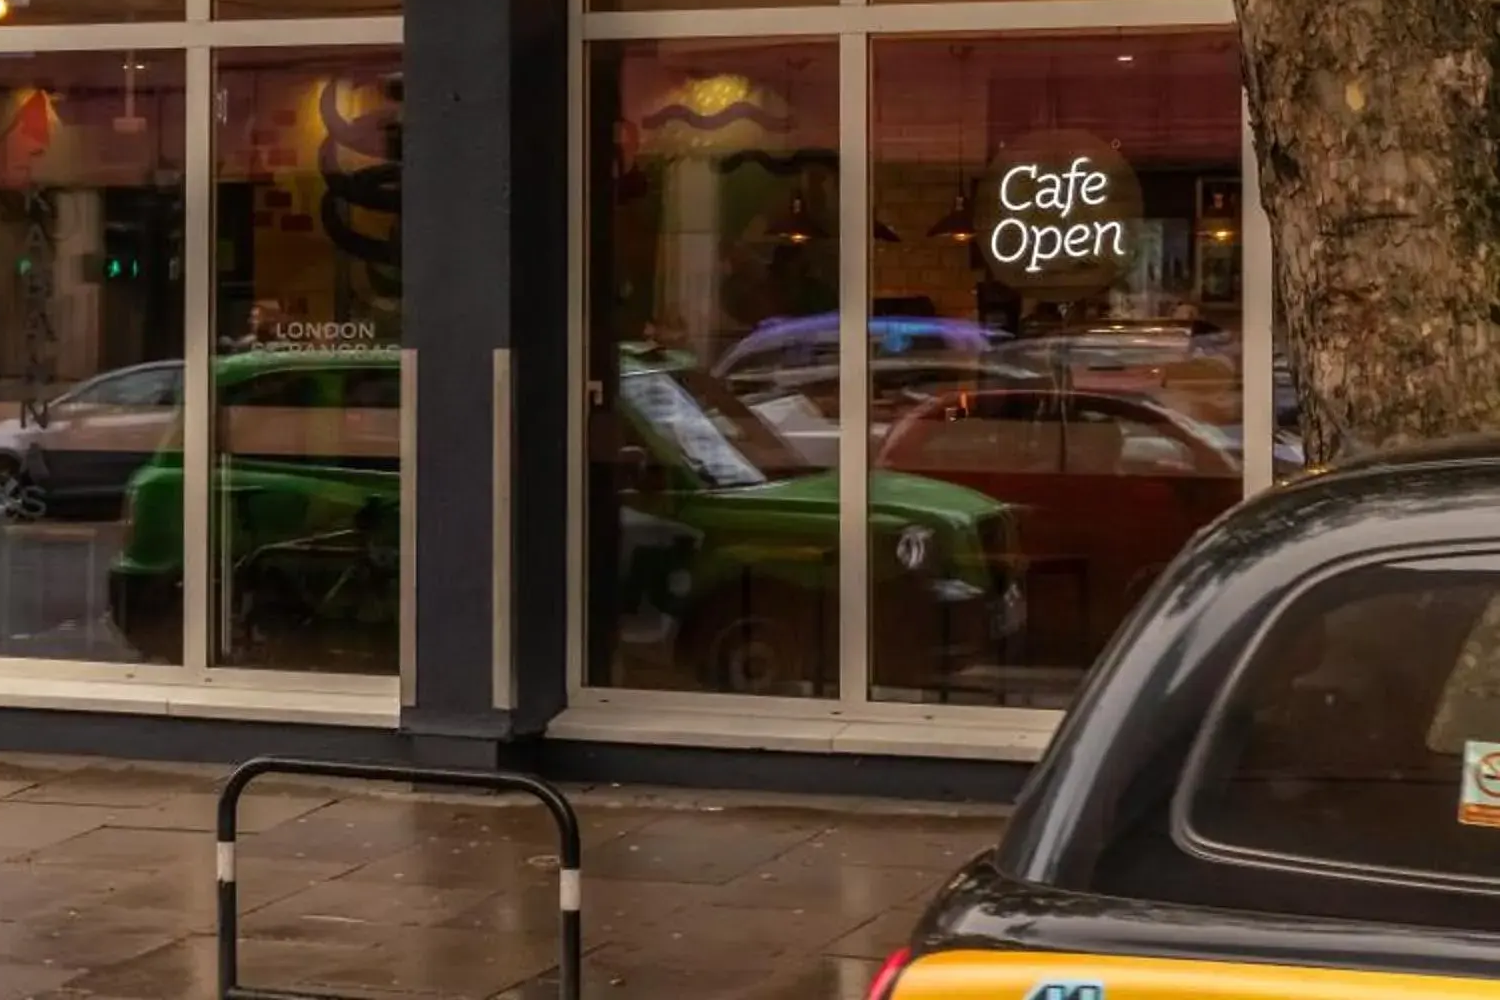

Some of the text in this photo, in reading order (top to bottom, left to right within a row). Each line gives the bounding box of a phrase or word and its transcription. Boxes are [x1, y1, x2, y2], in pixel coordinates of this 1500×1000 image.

[1000, 156, 1108, 218] Cafe
[991, 217, 1125, 273] Open
[276, 322, 376, 339] LONDON
